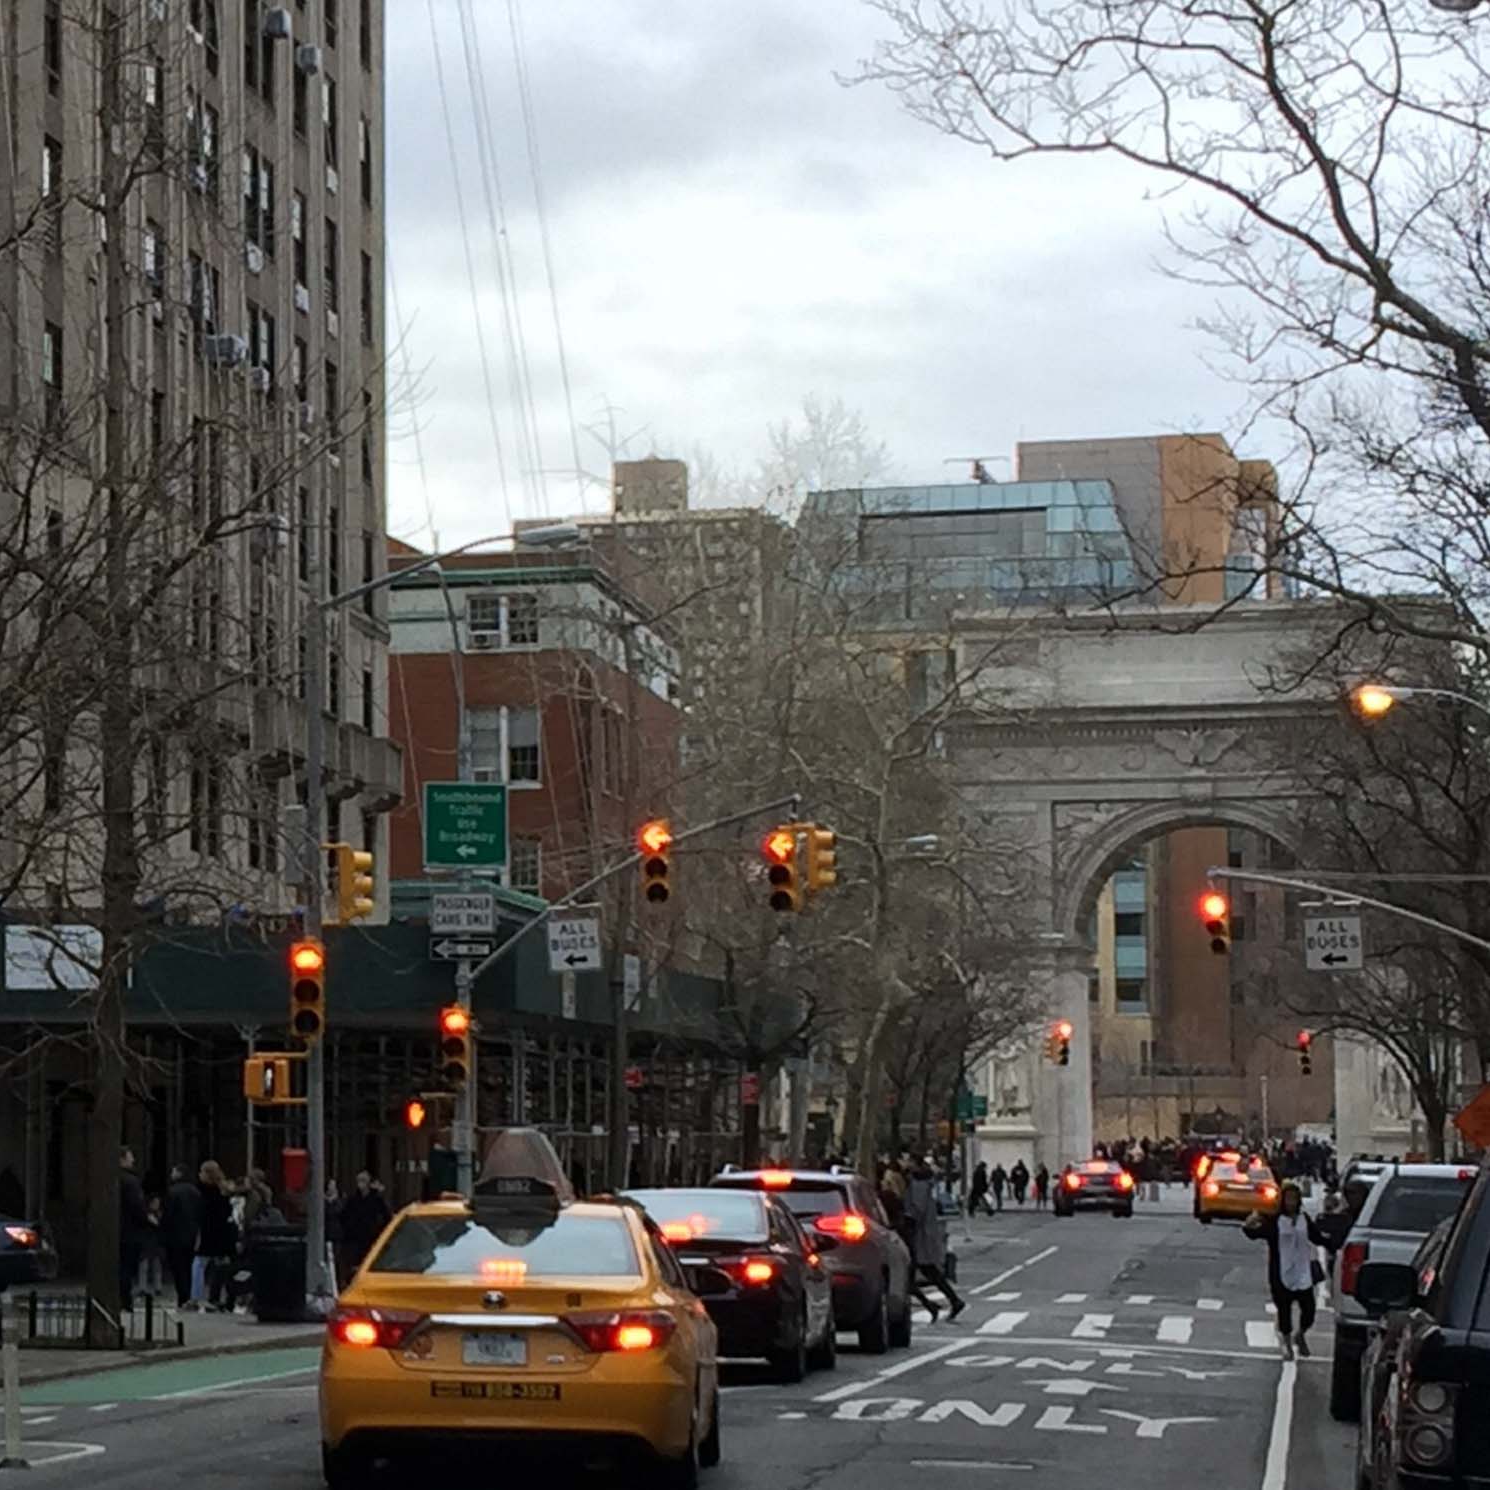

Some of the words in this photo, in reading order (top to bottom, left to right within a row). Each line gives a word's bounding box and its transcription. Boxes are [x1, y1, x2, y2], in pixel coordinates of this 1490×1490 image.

[448, 804, 484, 816] Traffic
[456, 818, 478, 830] Use
[438, 831, 496, 848] Broadway
[559, 923, 588, 935] ALL
[1317, 921, 1348, 933] ALL
[551, 937, 597, 951] BUSES
[1307, 934, 1359, 950] BUSES
[944, 1353, 1247, 1381] ONLY
[831, 1396, 1222, 1439] ONLY
